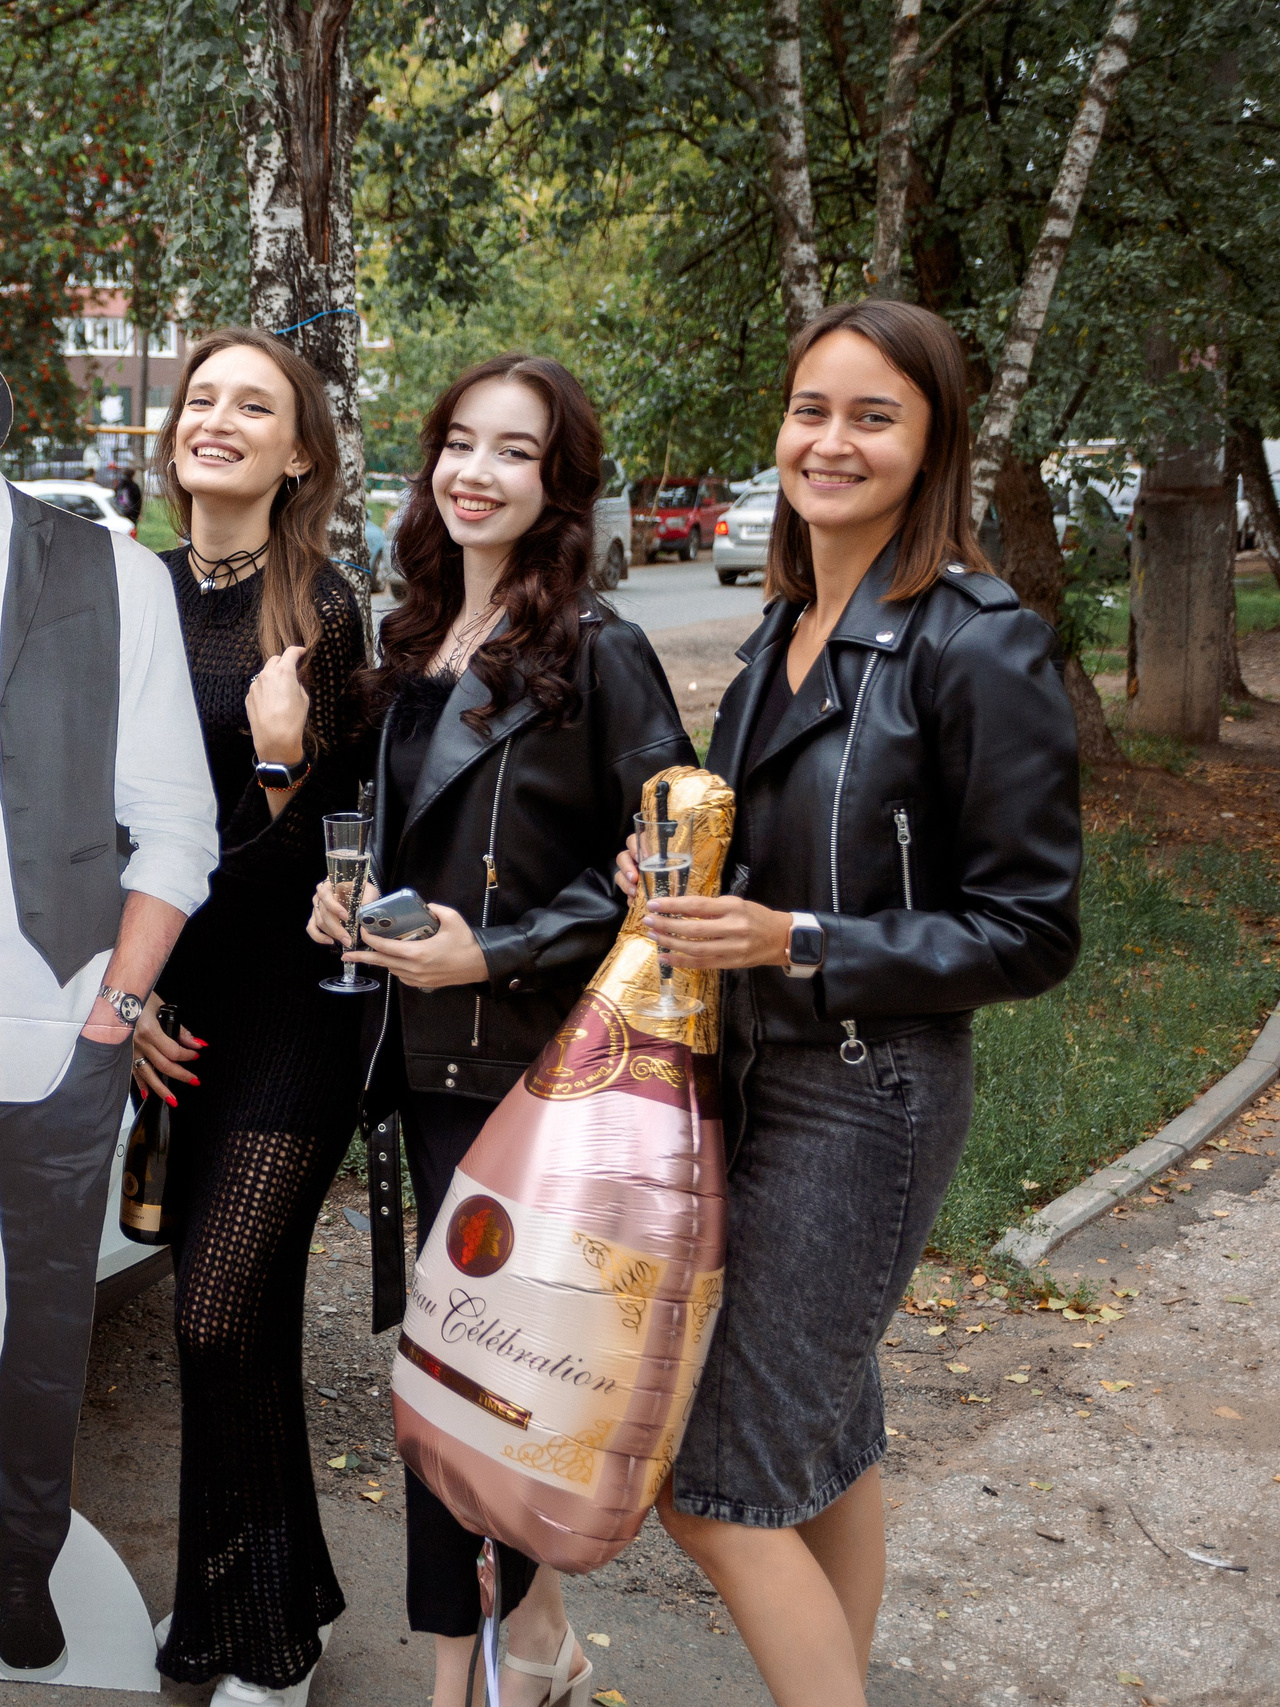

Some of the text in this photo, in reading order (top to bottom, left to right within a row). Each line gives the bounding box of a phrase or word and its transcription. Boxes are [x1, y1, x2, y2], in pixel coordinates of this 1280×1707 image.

[574, 1080, 586, 1088] to
[586, 1066, 613, 1083] Time
[441, 1287, 617, 1395] Célébration
[478, 1392, 517, 1420] TIMES
